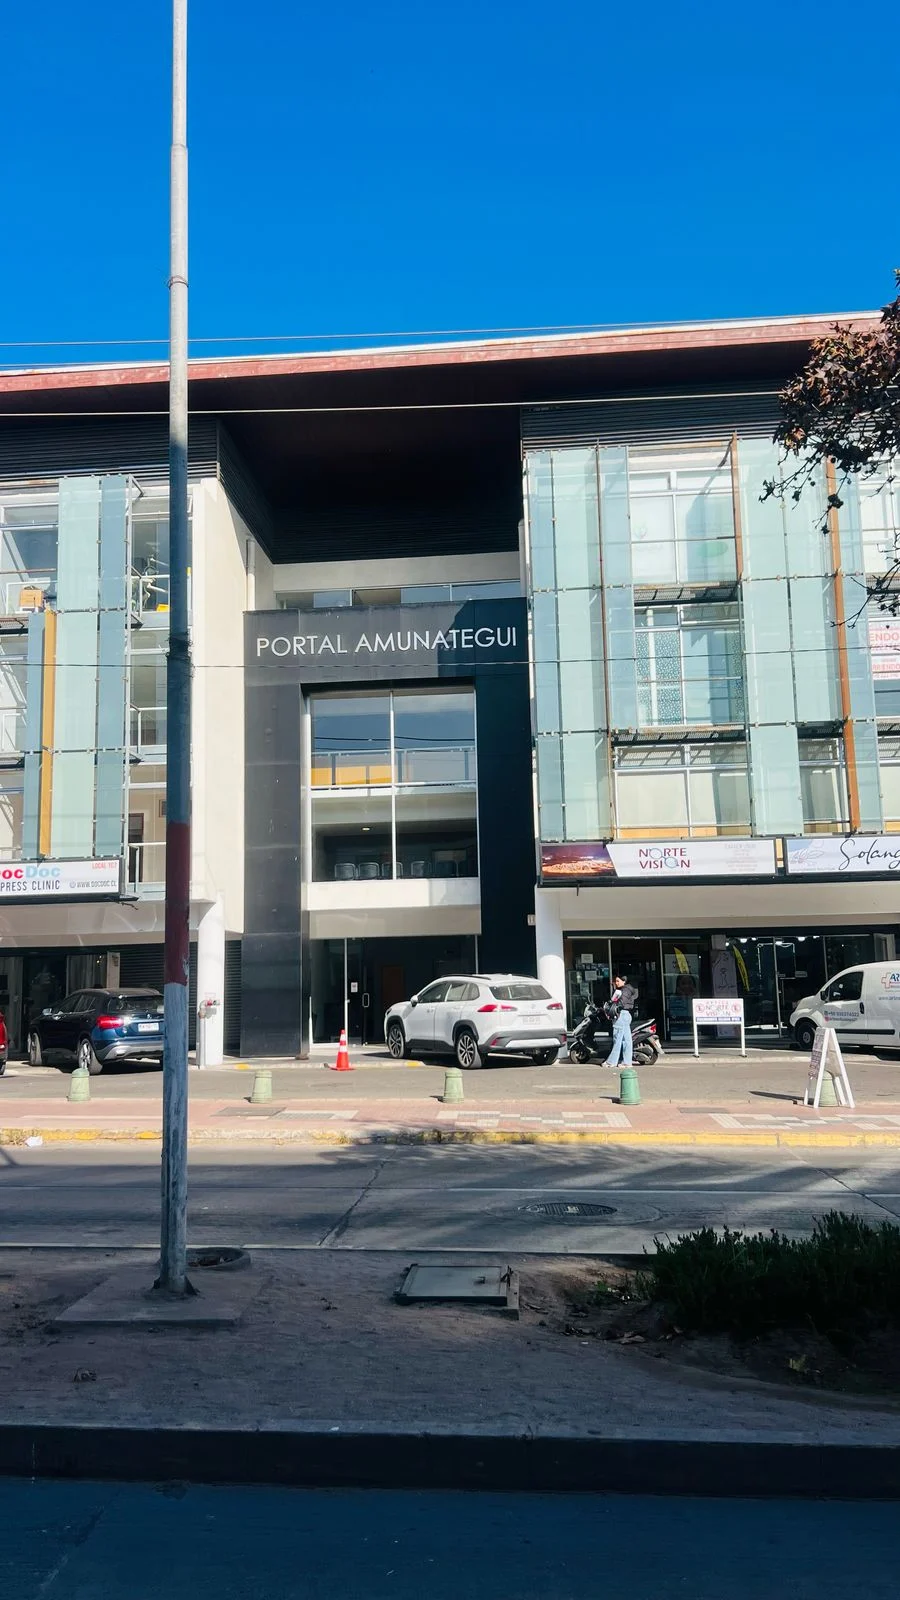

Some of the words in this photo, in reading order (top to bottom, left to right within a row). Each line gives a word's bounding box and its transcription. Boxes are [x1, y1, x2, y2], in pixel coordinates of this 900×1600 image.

[256, 635, 348, 657] PORTAL
[354, 626, 517, 653] AMUNATEGUI
[869, 632, 899, 642] ENDO
[639, 847, 687, 860] NORTE
[639, 857, 690, 869] VISION
[0, 865, 61, 879] ocDoc
[31, 879, 61, 891] CLINIC
